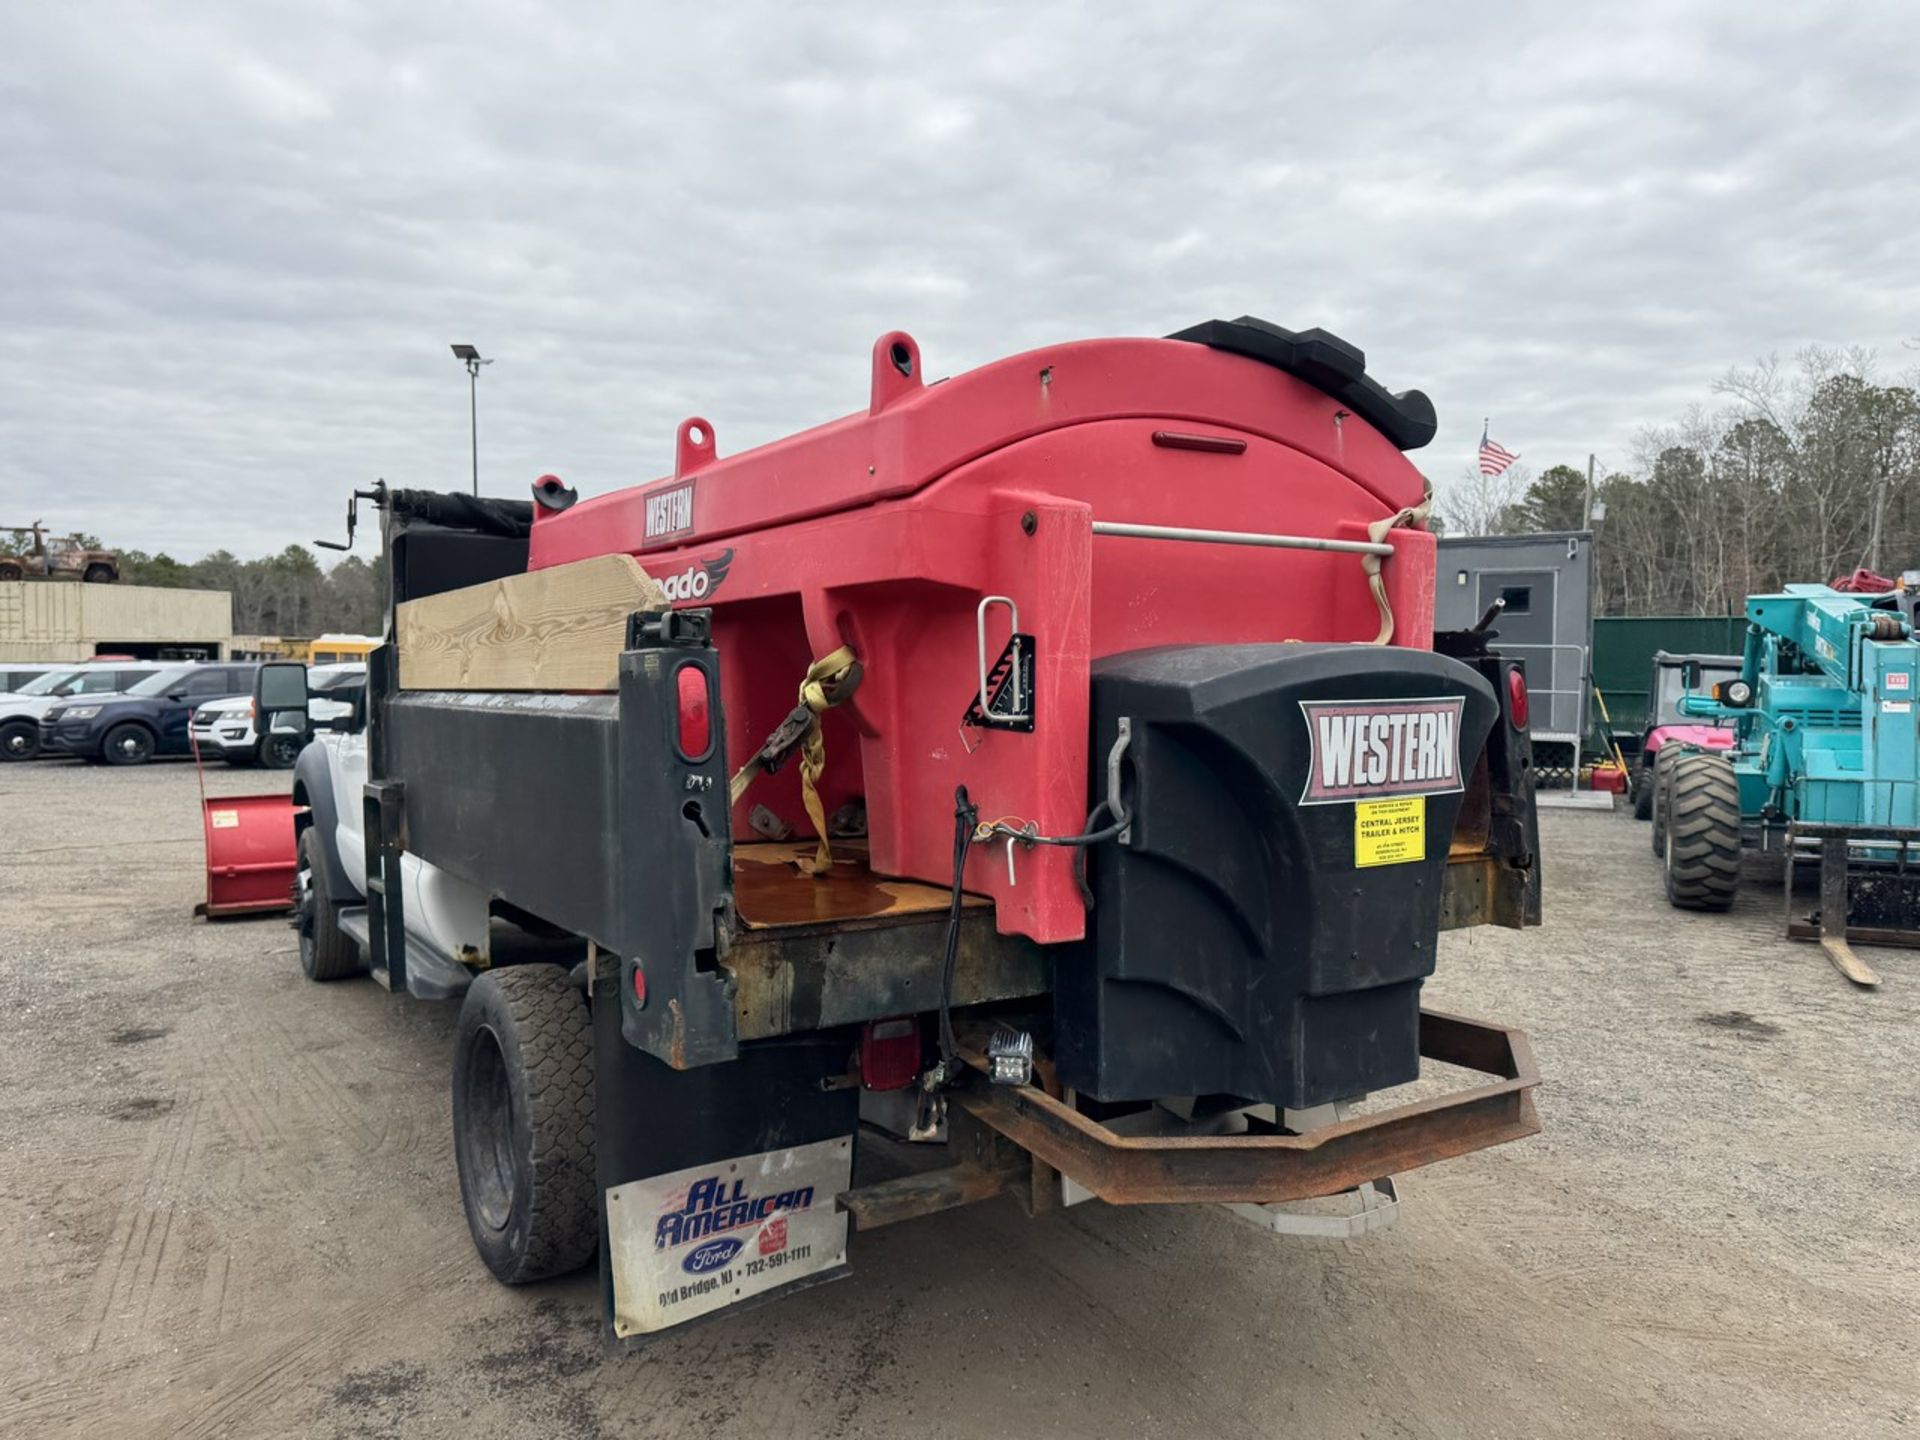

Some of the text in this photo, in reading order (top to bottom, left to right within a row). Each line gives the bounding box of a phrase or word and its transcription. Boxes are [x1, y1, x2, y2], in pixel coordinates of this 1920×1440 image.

[646, 486, 692, 537] WESTERN
[1319, 712, 1455, 787] WESTERN
[1360, 815, 1420, 829] CENTRAL JERSEY
[1361, 825, 1420, 839] TRAILER & HITCH
[683, 1176, 747, 1214] ALL
[655, 1186, 815, 1250] AMERICAN
[680, 1276, 720, 1302] Bridge,
[720, 1269, 733, 1289] NJ
[745, 1246, 812, 1278] 732-591-1111
[692, 1243, 736, 1272] Ford
